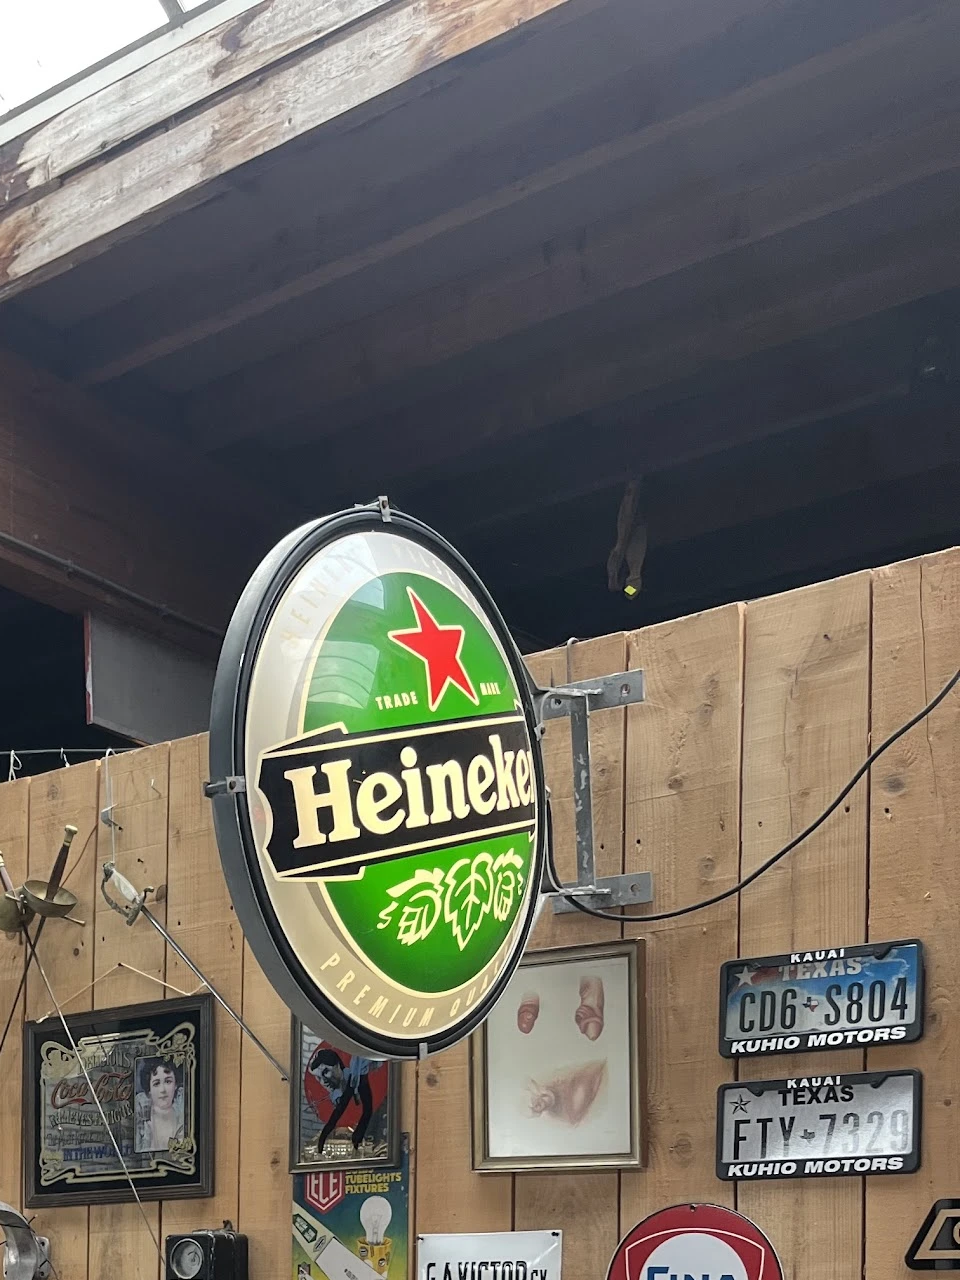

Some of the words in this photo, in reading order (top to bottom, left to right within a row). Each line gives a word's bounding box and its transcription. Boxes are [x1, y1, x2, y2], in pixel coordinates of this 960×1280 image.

[375, 691, 419, 710] TRADE
[480, 682, 501, 696] MARK
[790, 948, 845, 963] KAUAI
[779, 957, 864, 982] TEXAS
[320, 953, 435, 1027] PREMIUM
[740, 988, 797, 1033] CD6
[824, 977, 908, 1026] S804
[730, 1036, 800, 1054] KUHIO
[807, 1026, 906, 1047] MOTORS
[787, 1076, 840, 1089] KAUAI
[778, 1085, 854, 1107] TEXAS
[733, 1116, 796, 1161] FTY
[819, 1109, 909, 1156] 7329
[345, 1172, 402, 1185] TUBELIGHTS
[727, 1162, 797, 1177] KUHIO
[804, 1157, 904, 1174] MOTORS
[345, 1183, 390, 1194] FIXTURES
